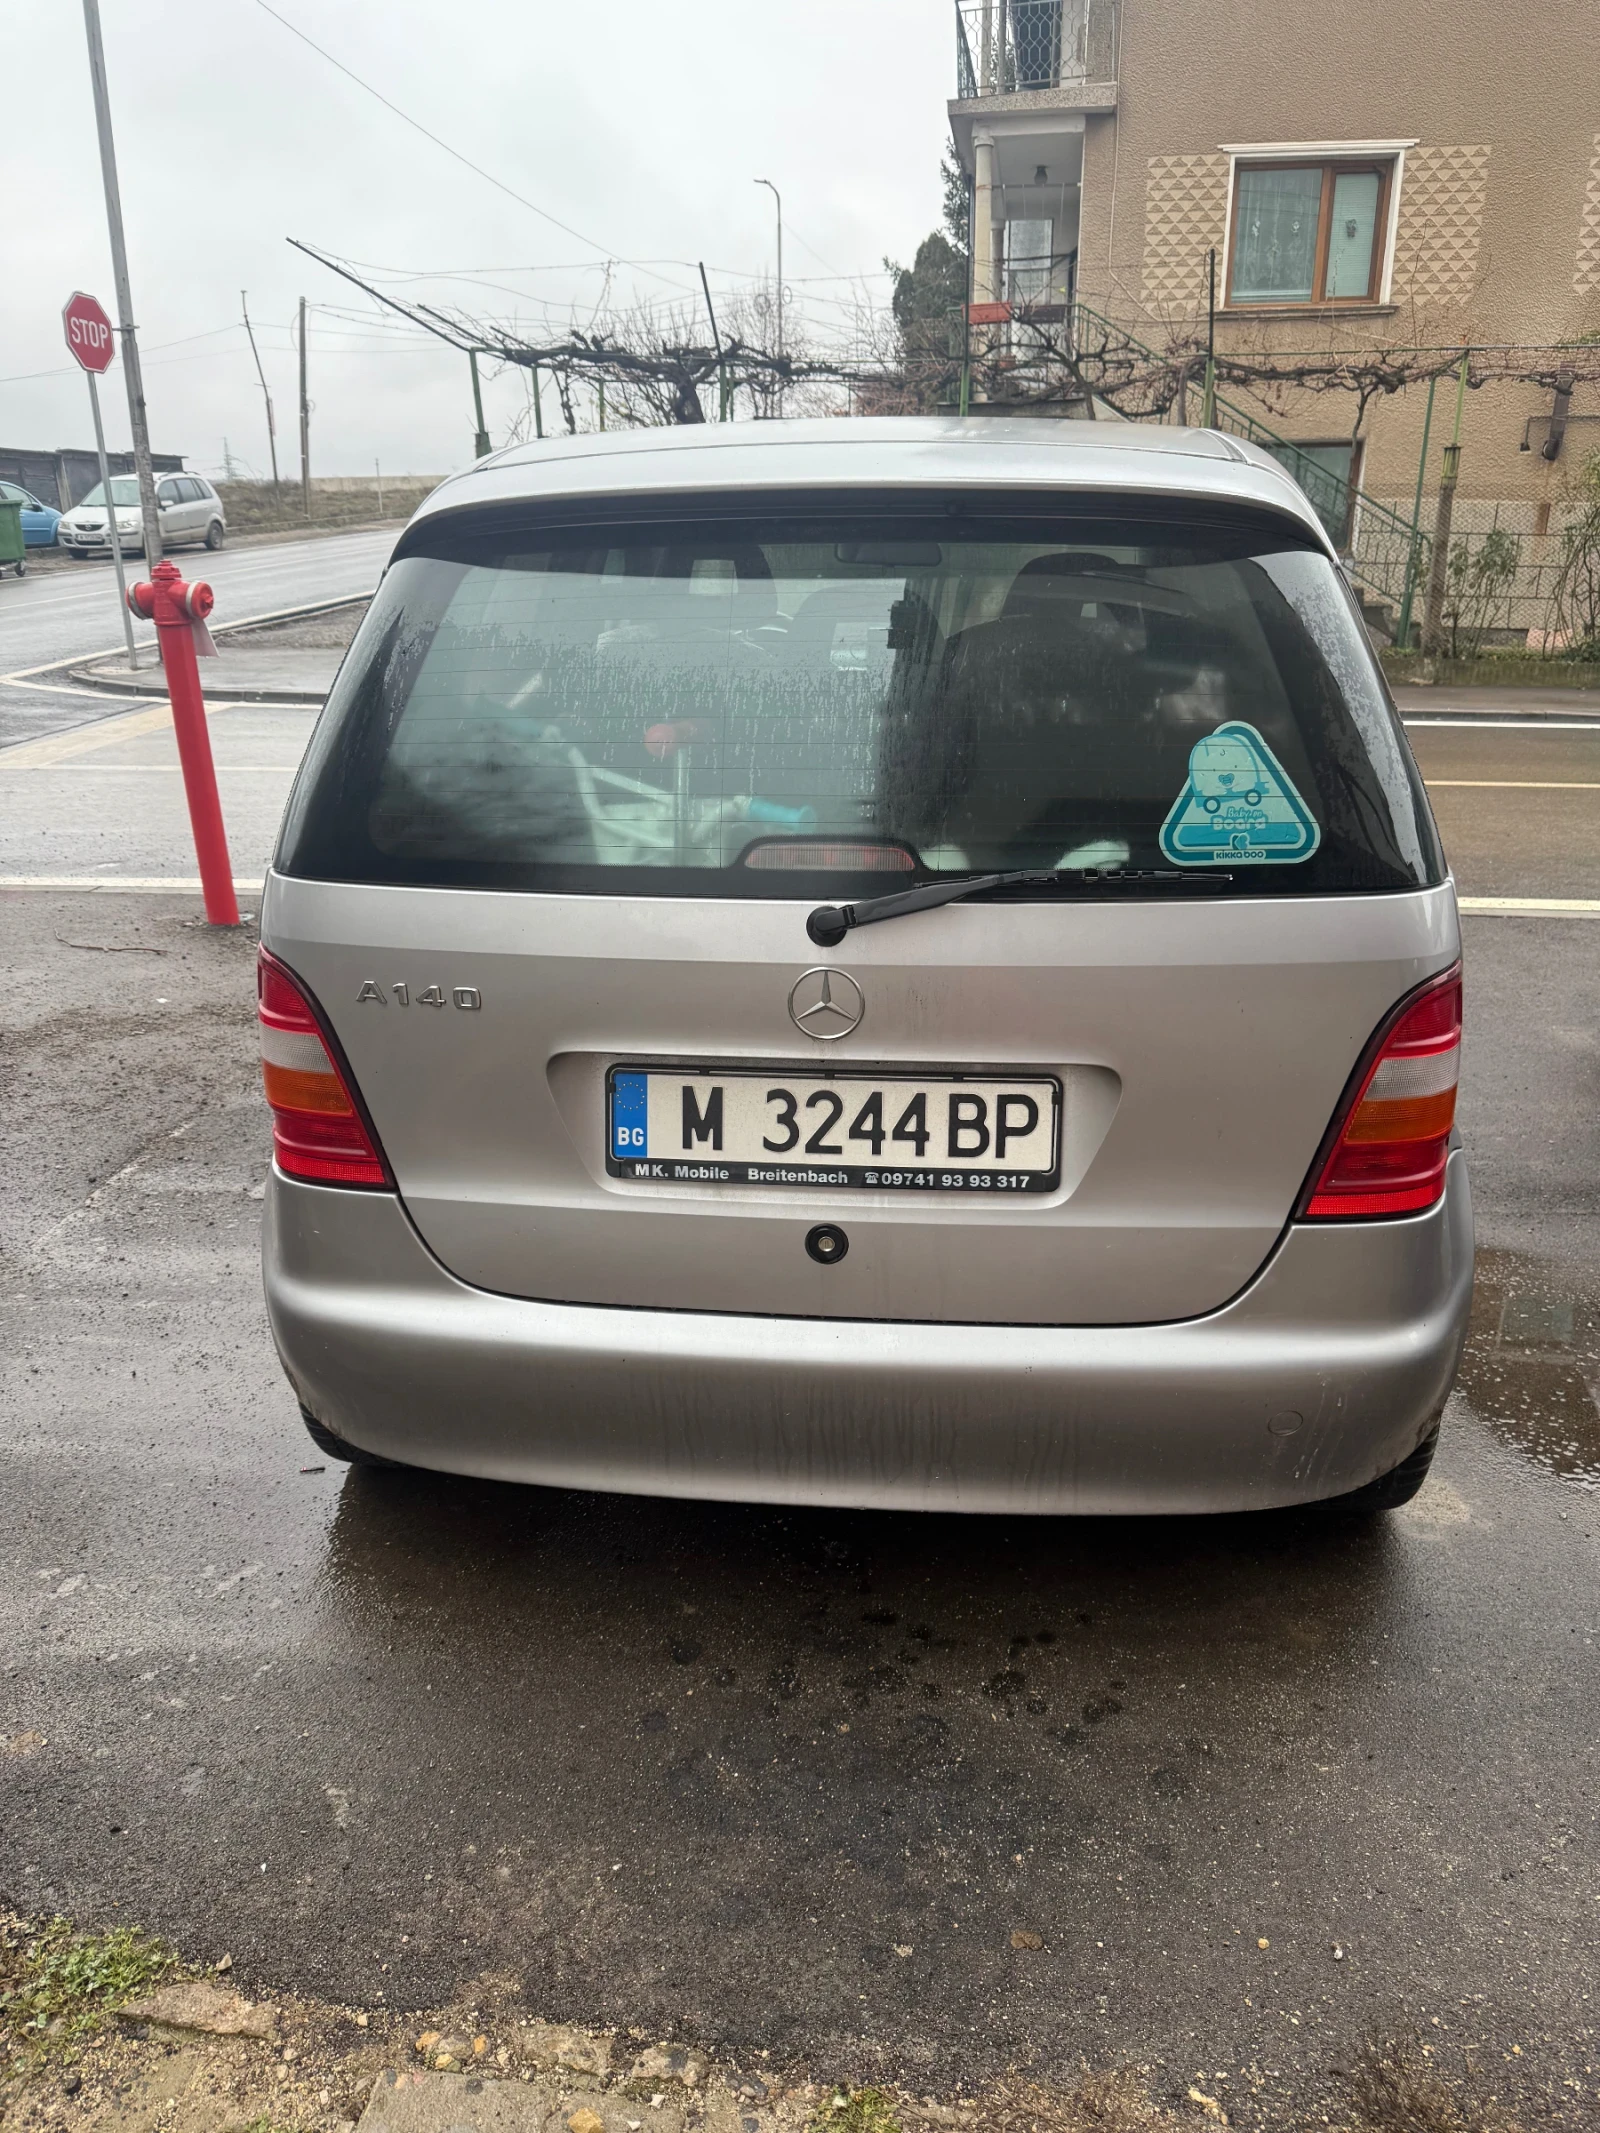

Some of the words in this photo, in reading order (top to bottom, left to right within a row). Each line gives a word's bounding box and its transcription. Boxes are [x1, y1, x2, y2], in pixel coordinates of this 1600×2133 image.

[70, 316, 108, 349] STOP
[1227, 806, 1251, 822] Baby
[356, 980, 482, 1009] A140
[682, 1086, 723, 1151] M
[763, 1088, 930, 1158] 3244
[948, 1093, 1039, 1159] BP
[617, 1127, 645, 1147] BG
[674, 1165, 730, 1180] Mobile
[747, 1168, 848, 1184] Breitenbach
[881, 1172, 935, 1186] 09741
[941, 1174, 964, 1187] 93
[969, 1175, 992, 1188] 93
[996, 1175, 1031, 1188] 317
